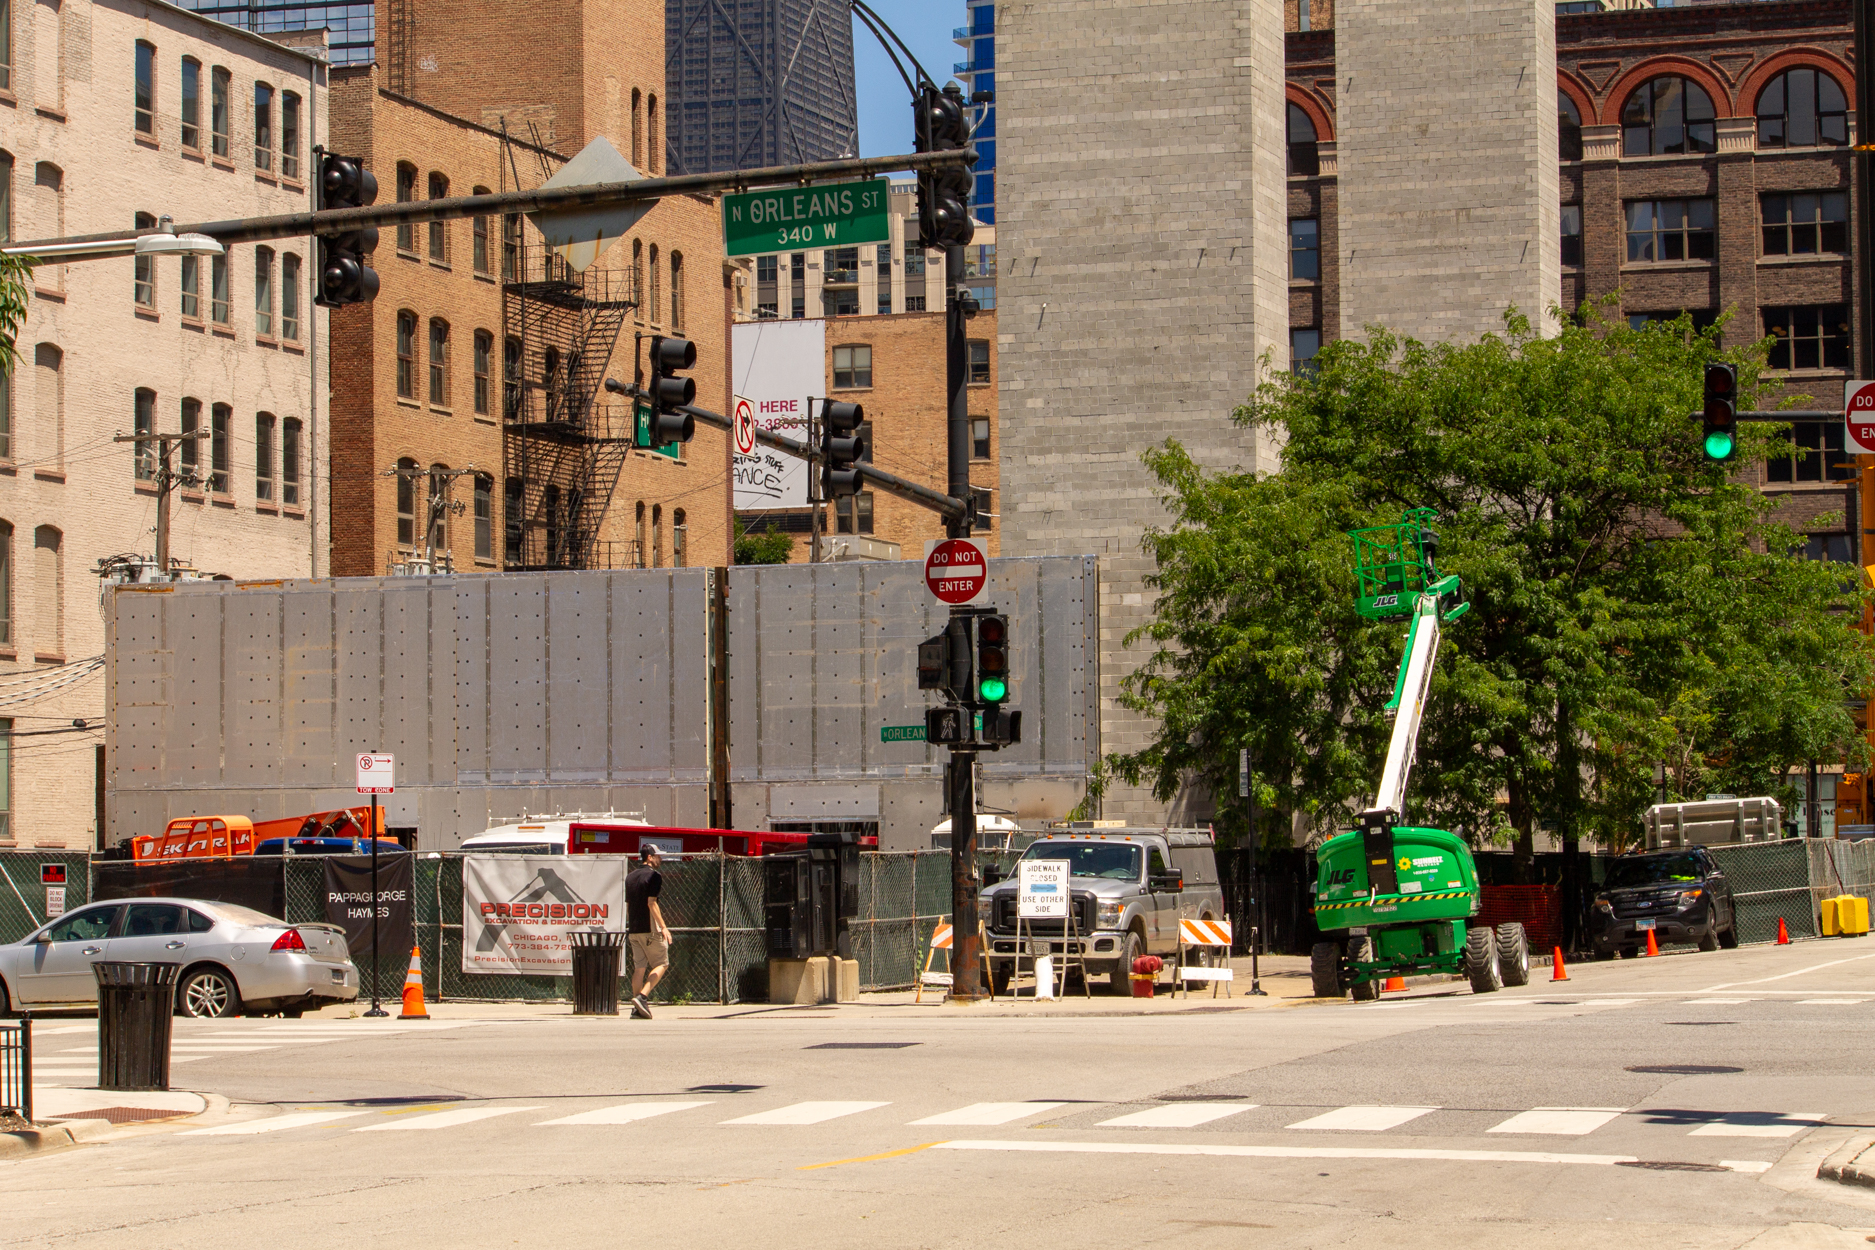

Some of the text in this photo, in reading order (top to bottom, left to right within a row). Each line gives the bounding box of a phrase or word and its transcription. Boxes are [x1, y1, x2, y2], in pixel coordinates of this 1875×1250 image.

[732, 190, 879, 224] N ORLEANS ST
[777, 222, 837, 244] 340 W
[760, 399, 798, 413] HERE
[1856, 395, 1873, 407] DO
[764, 454, 784, 474] STUFF
[933, 551, 977, 564] DO NOT
[938, 580, 974, 592] ENTER
[1373, 594, 1398, 608] JLG
[888, 728, 926, 740] ORLEAN
[49, 865, 58, 874] NO
[1026, 865, 1062, 873] SIDEWALK
[42, 873, 65, 882] PARKING
[1326, 868, 1356, 886] JLG
[1022, 895, 1064, 903] USE OTHER
[480, 902, 609, 918] PRECISION
[1035, 905, 1051, 913] SIDE
[484, 918, 605, 926] EXCAVATION & DEMOLITION
[513, 934, 562, 943] CHICAGO,
[508, 943, 572, 951] 773-384-720
